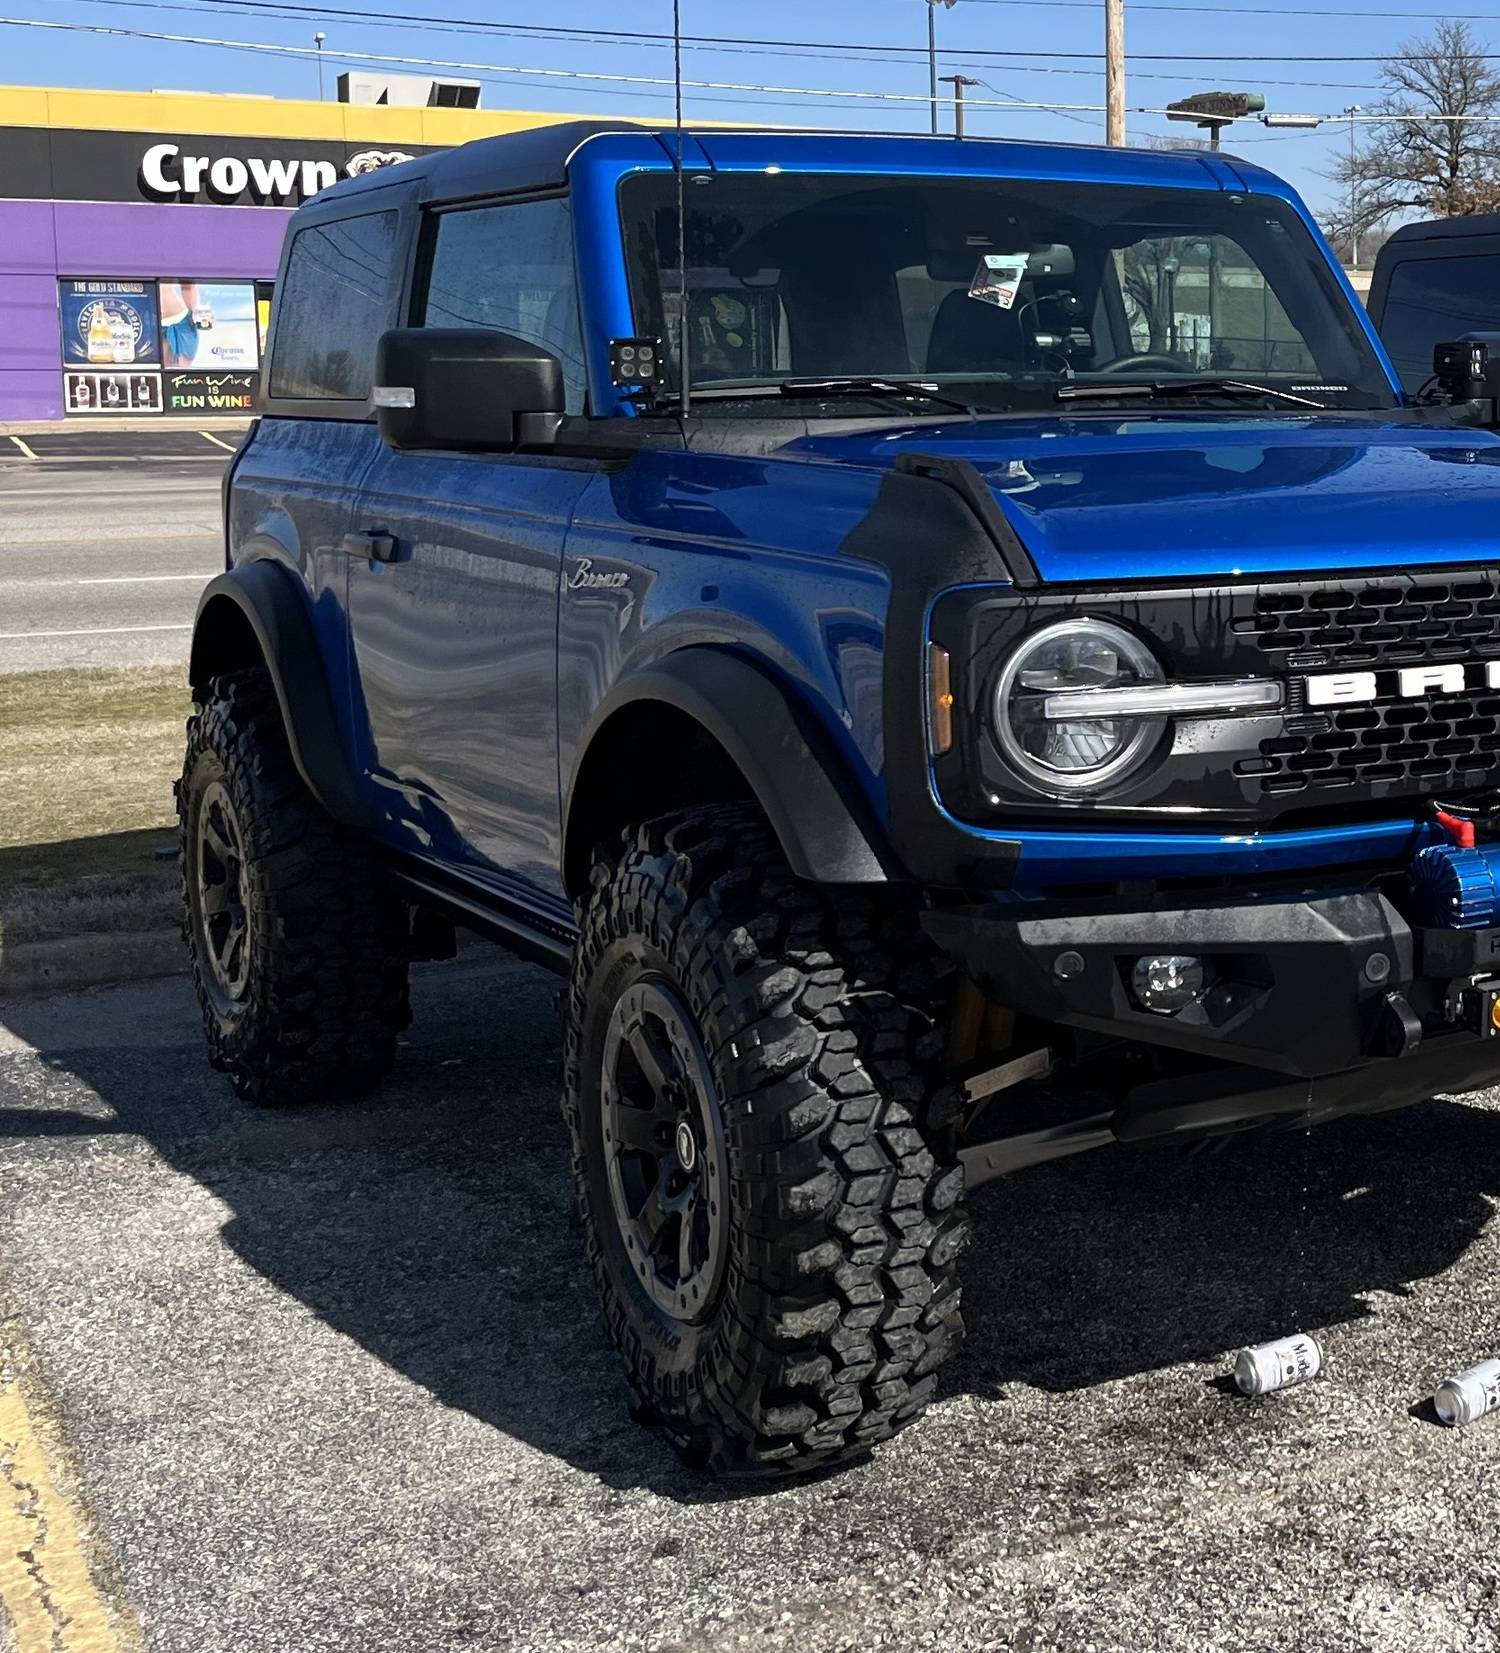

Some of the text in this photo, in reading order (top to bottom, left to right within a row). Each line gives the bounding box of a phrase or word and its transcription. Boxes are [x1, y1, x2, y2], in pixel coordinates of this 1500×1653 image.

[142, 143, 337, 196] Crown
[73, 281, 86, 292] THE
[88, 281, 107, 293] GOLD
[171, 374, 252, 388] Fun Wine
[208, 386, 220, 395] IS
[171, 395, 253, 408] FUN WINE
[568, 558, 631, 588] Bronco
